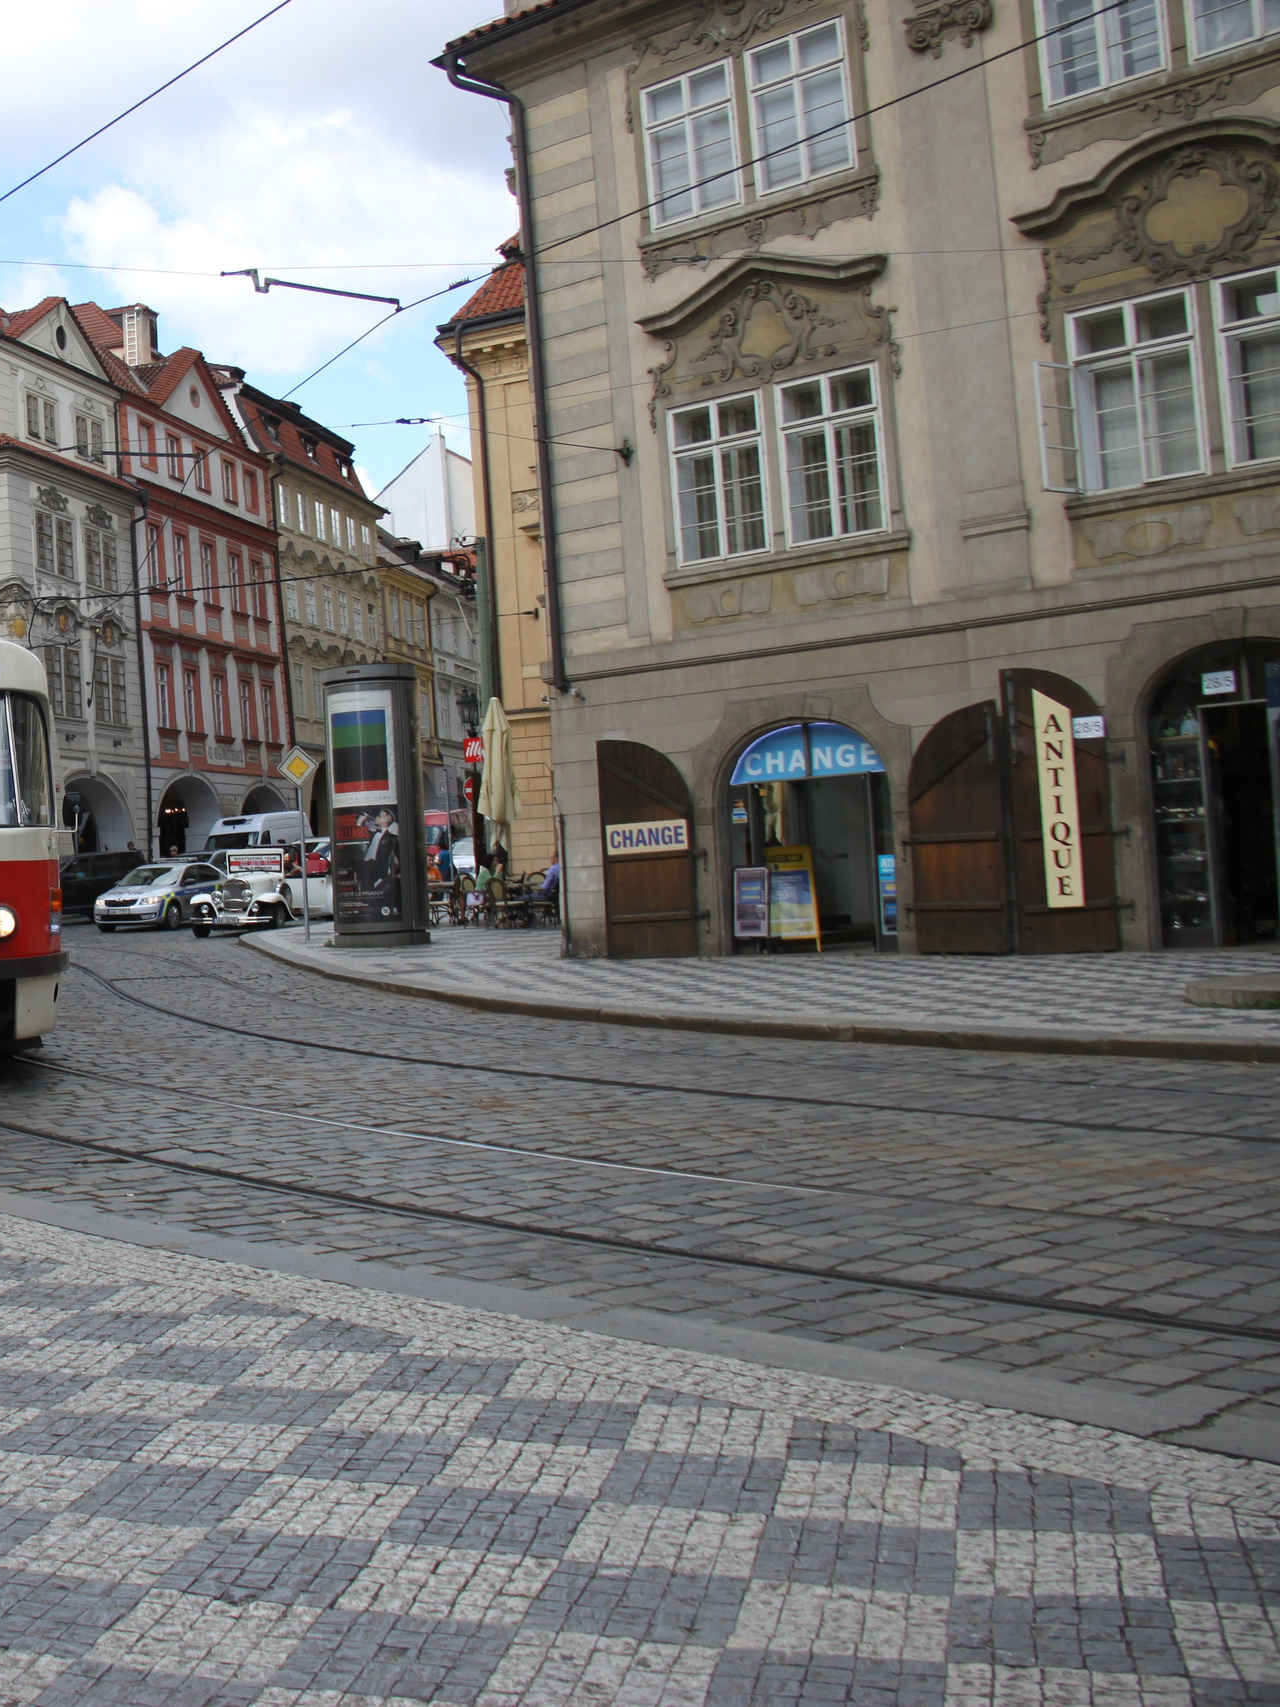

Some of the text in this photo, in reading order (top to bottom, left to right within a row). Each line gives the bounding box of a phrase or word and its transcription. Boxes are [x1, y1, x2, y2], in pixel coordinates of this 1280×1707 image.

[743, 742, 878, 777] CHANGE
[1042, 713, 1074, 897] ANTIQUE
[609, 825, 685, 850] CHANGE
